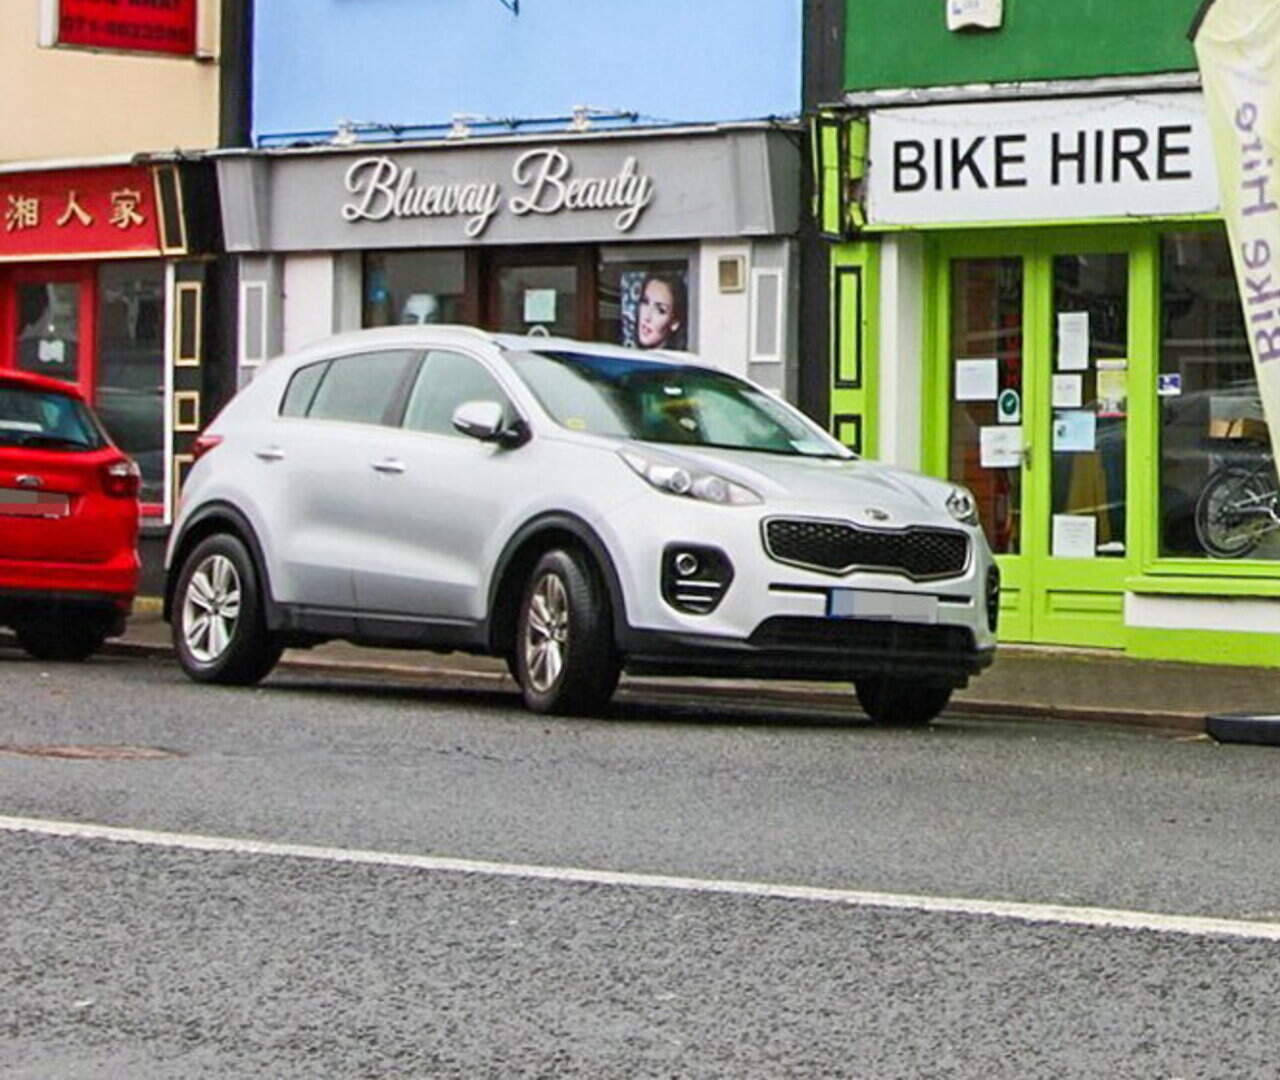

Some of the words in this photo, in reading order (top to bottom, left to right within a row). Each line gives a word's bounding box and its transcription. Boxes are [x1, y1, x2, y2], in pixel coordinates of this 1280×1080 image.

[341, 156, 501, 237] Blueway
[509, 147, 654, 232] Beauty
[893, 134, 1028, 193] BIKE
[1051, 125, 1193, 186] HIRE
[1235, 101, 1279, 217] Hire
[5, 188, 145, 233] 湘人家
